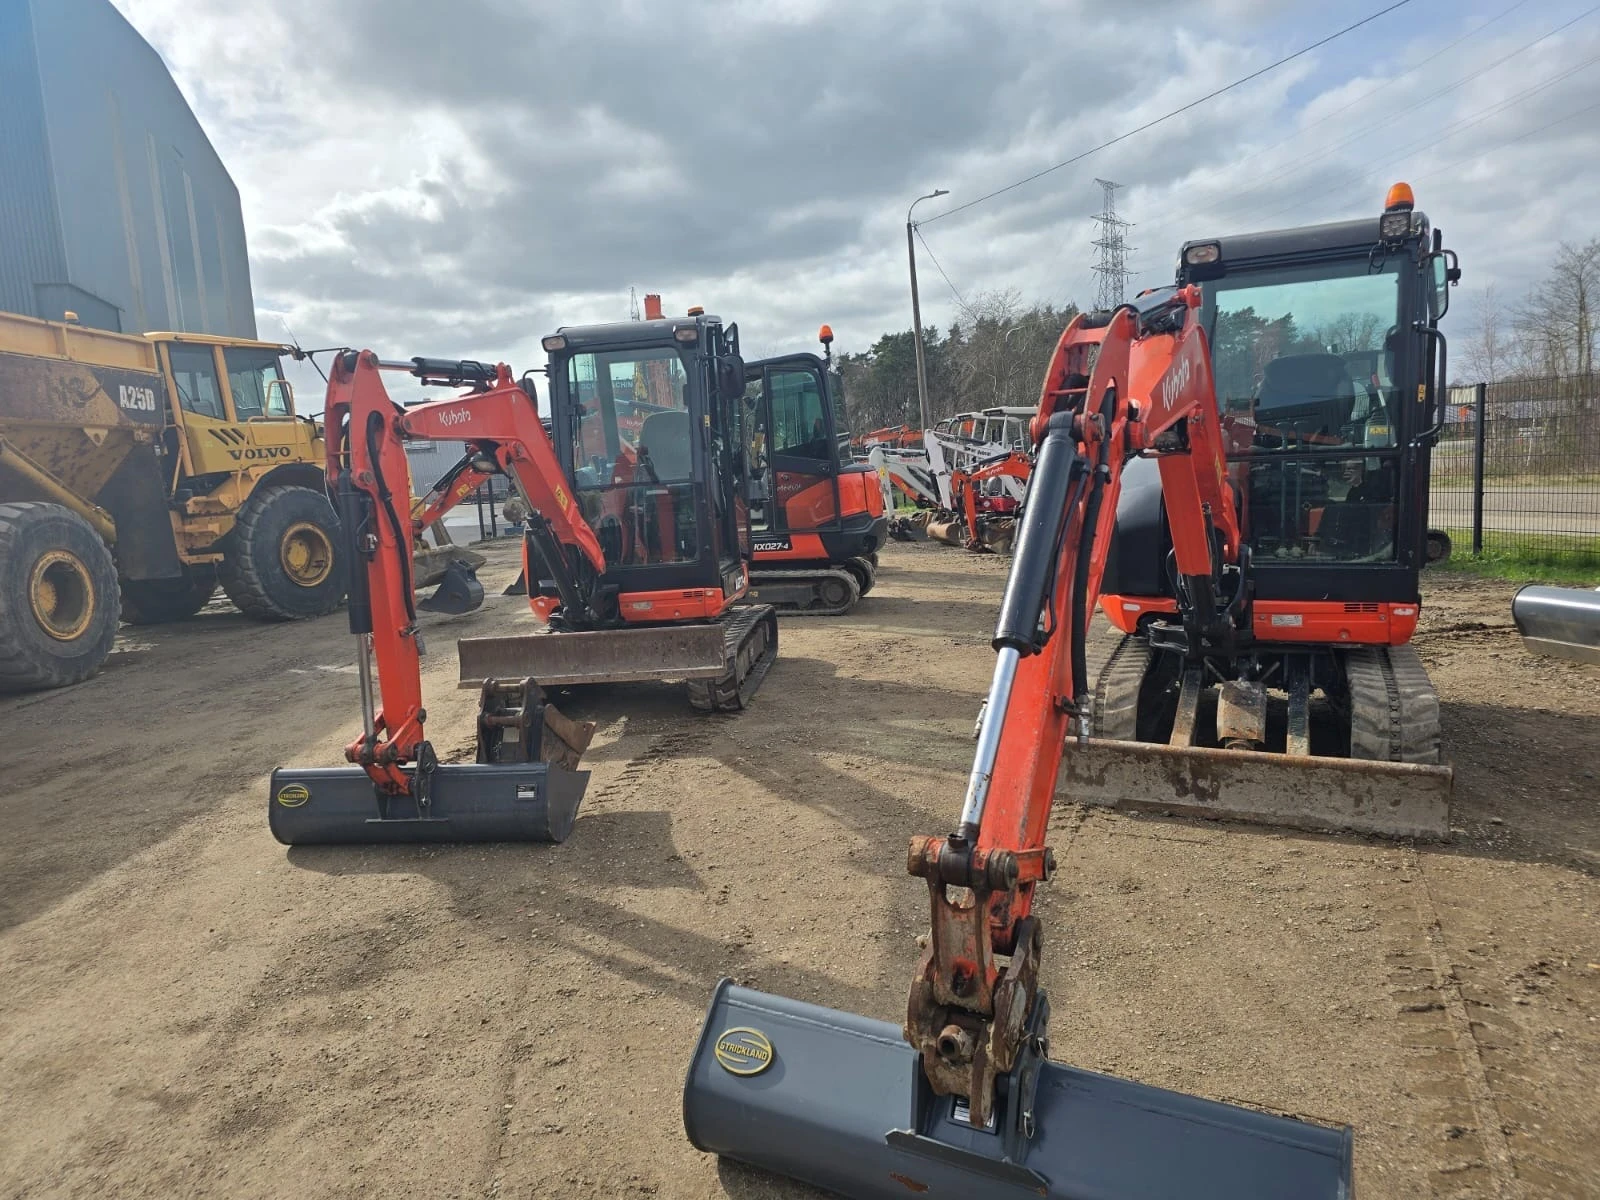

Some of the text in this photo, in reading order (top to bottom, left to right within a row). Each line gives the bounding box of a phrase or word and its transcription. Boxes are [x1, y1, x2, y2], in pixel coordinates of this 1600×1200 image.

[1162, 355, 1190, 411] Kubota
[119, 385, 156, 411] A25D
[438, 407, 471, 426] Kubota
[226, 446, 291, 460] VOLVO
[753, 542, 789, 551] KX027-4
[719, 1041, 768, 1061] STRICKLAND
